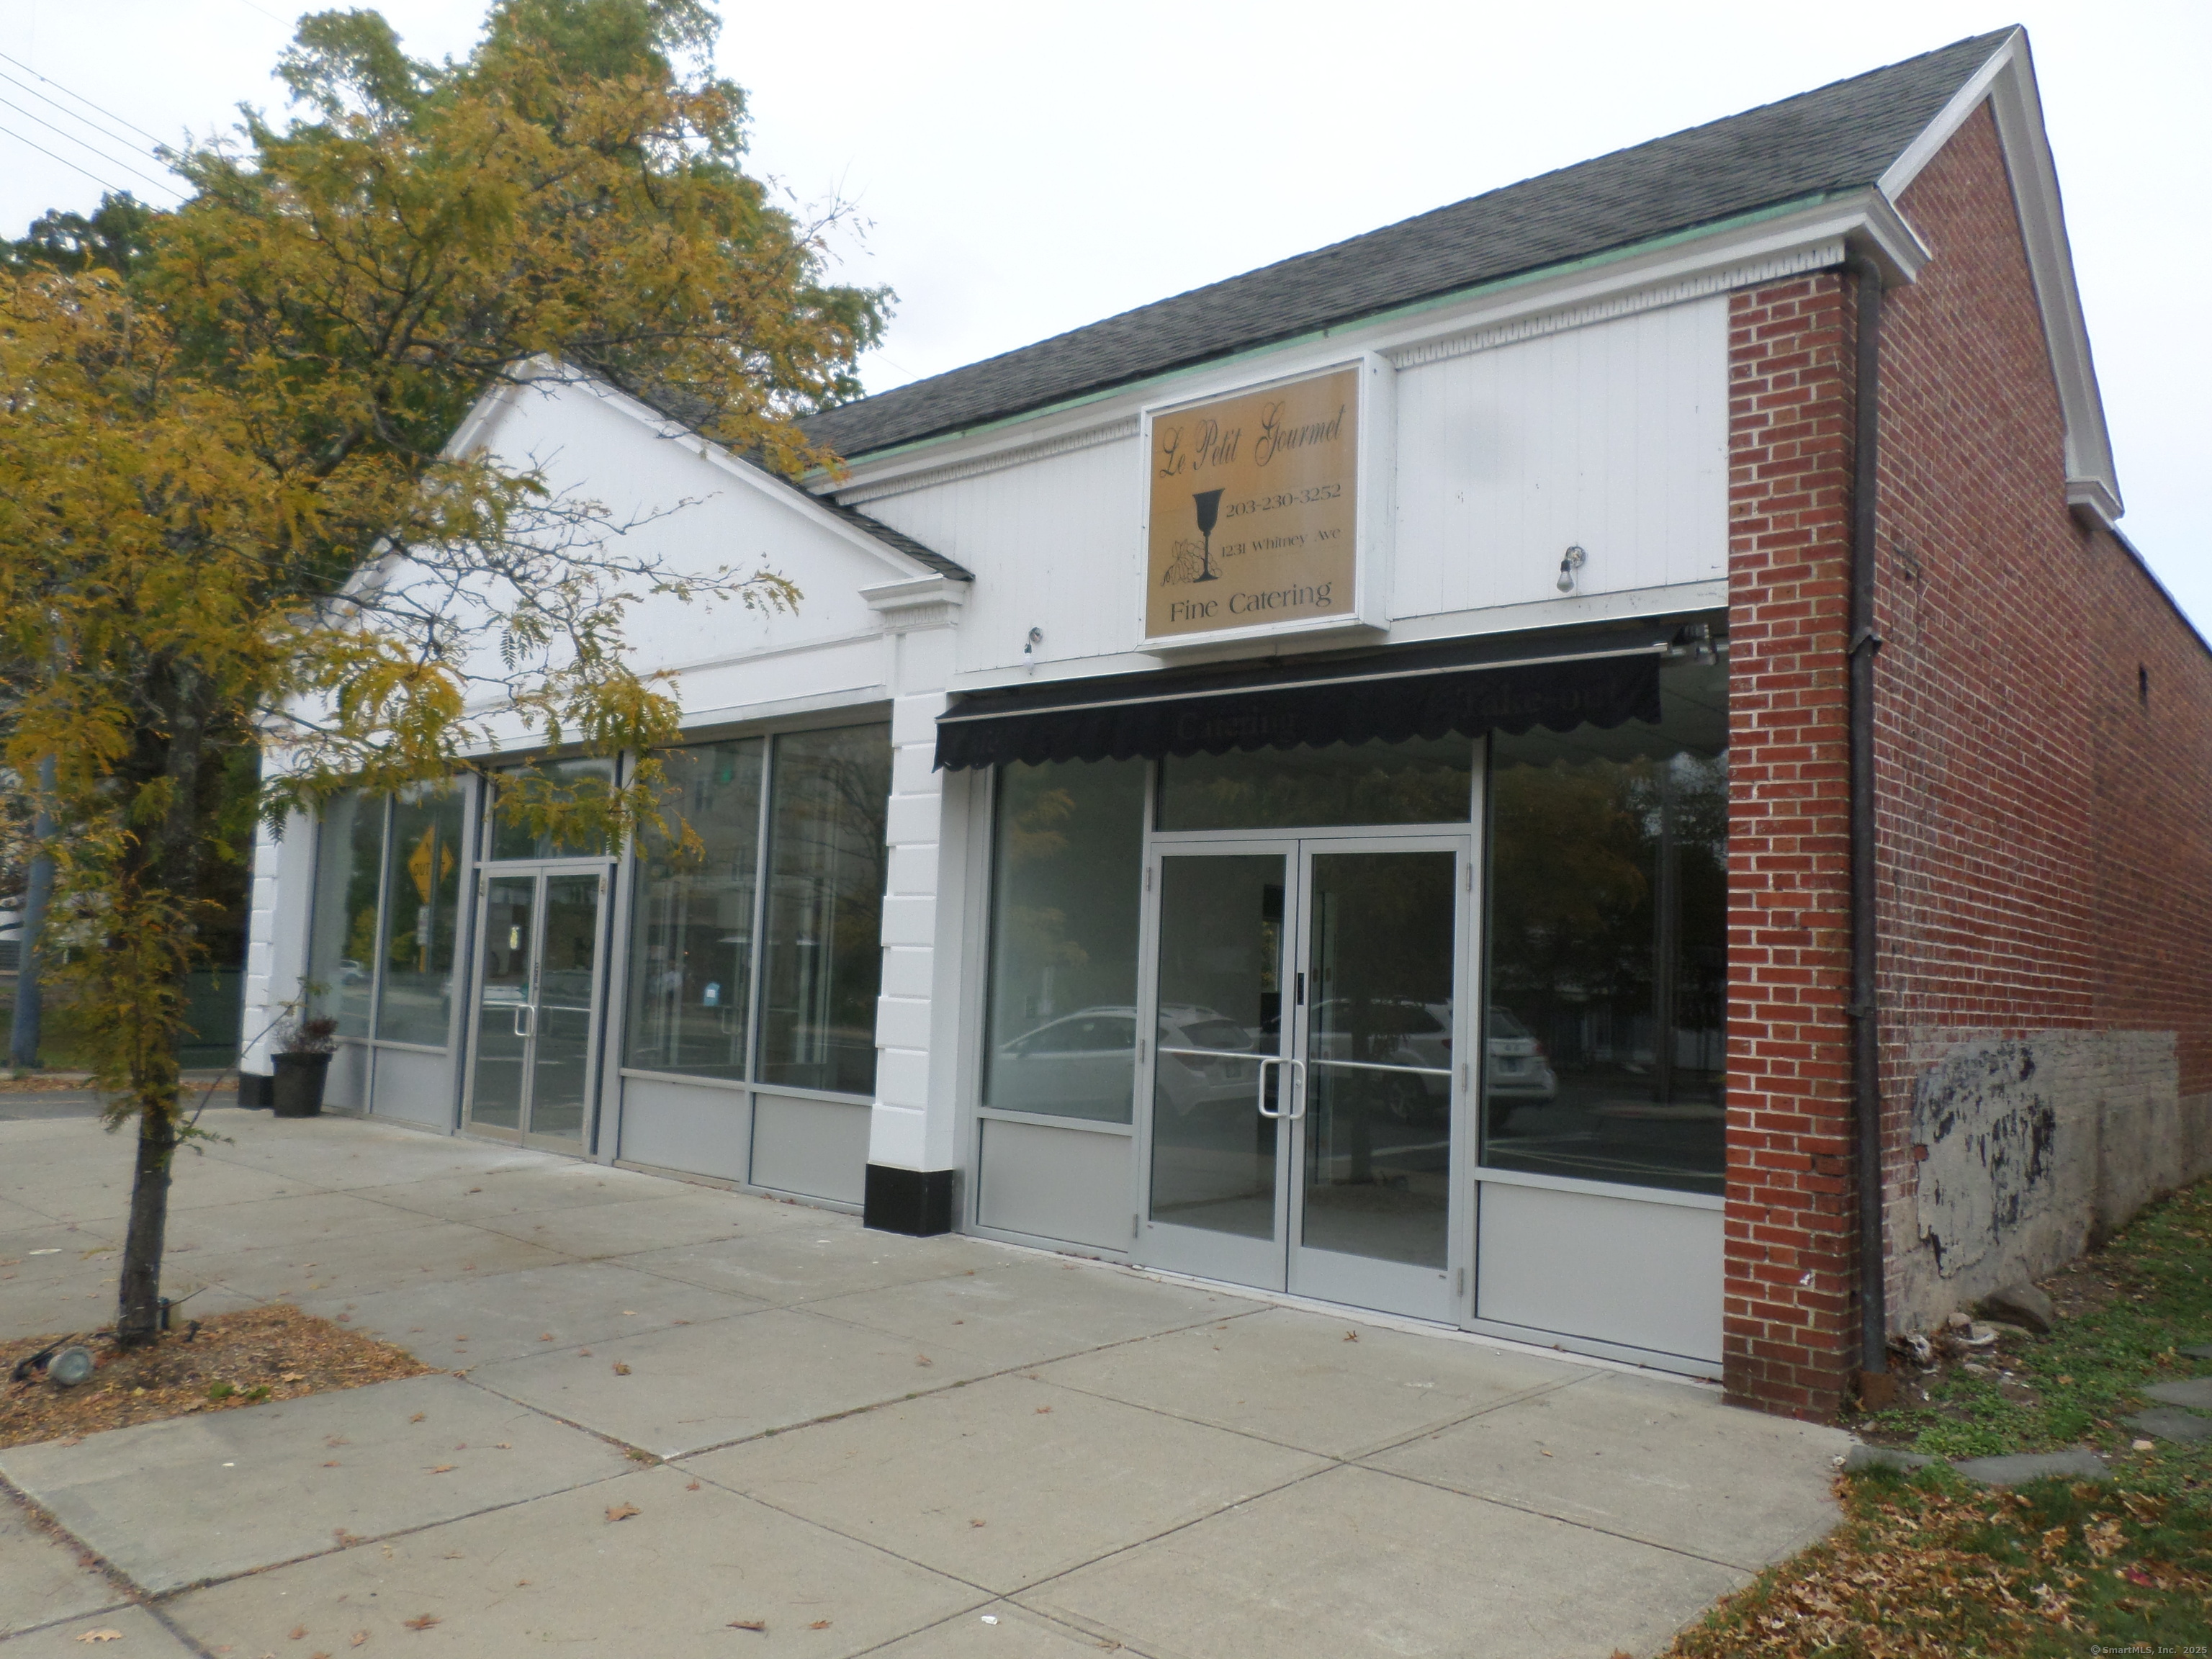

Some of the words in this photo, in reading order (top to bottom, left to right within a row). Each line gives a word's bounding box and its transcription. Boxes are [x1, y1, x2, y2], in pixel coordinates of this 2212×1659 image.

[1159, 426, 1186, 478] Le
[1193, 419, 1242, 470] Petit
[1254, 400, 1346, 467] Gourmet
[1226, 483, 1341, 518] 203-230-3252
[1221, 543, 1246, 558] 1231
[1251, 534, 1309, 552] Whitney
[1314, 528, 1341, 542] Ave
[1171, 599, 1219, 622] Fine
[1228, 581, 1332, 614] Catering
